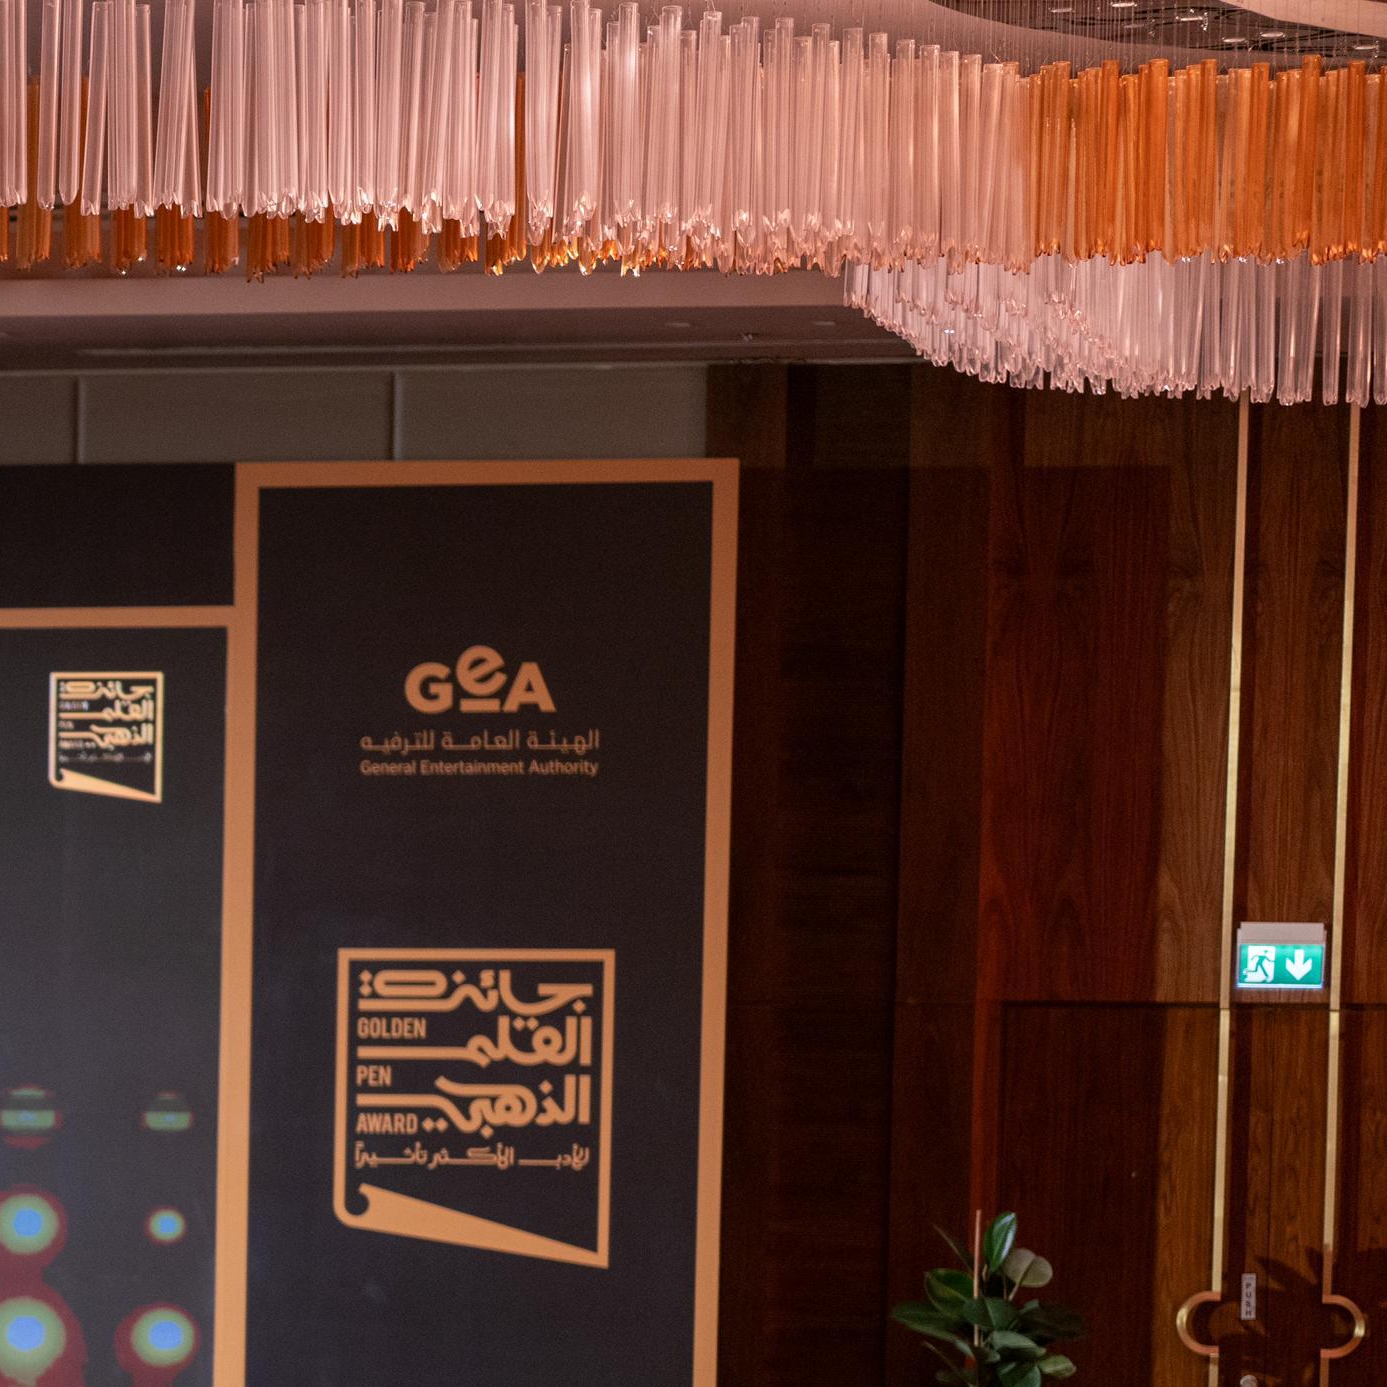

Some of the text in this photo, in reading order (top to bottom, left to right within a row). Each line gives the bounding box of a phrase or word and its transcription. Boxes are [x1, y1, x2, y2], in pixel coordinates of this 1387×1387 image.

[359, 729, 435, 755] للترفيه
[441, 728, 520, 751] العامة
[359, 759, 599, 779] General Entertainment Authority
[357, 1016, 427, 1040] GOLDEN
[356, 1065, 392, 1087] PEN
[355, 1112, 418, 1135] AWARD
